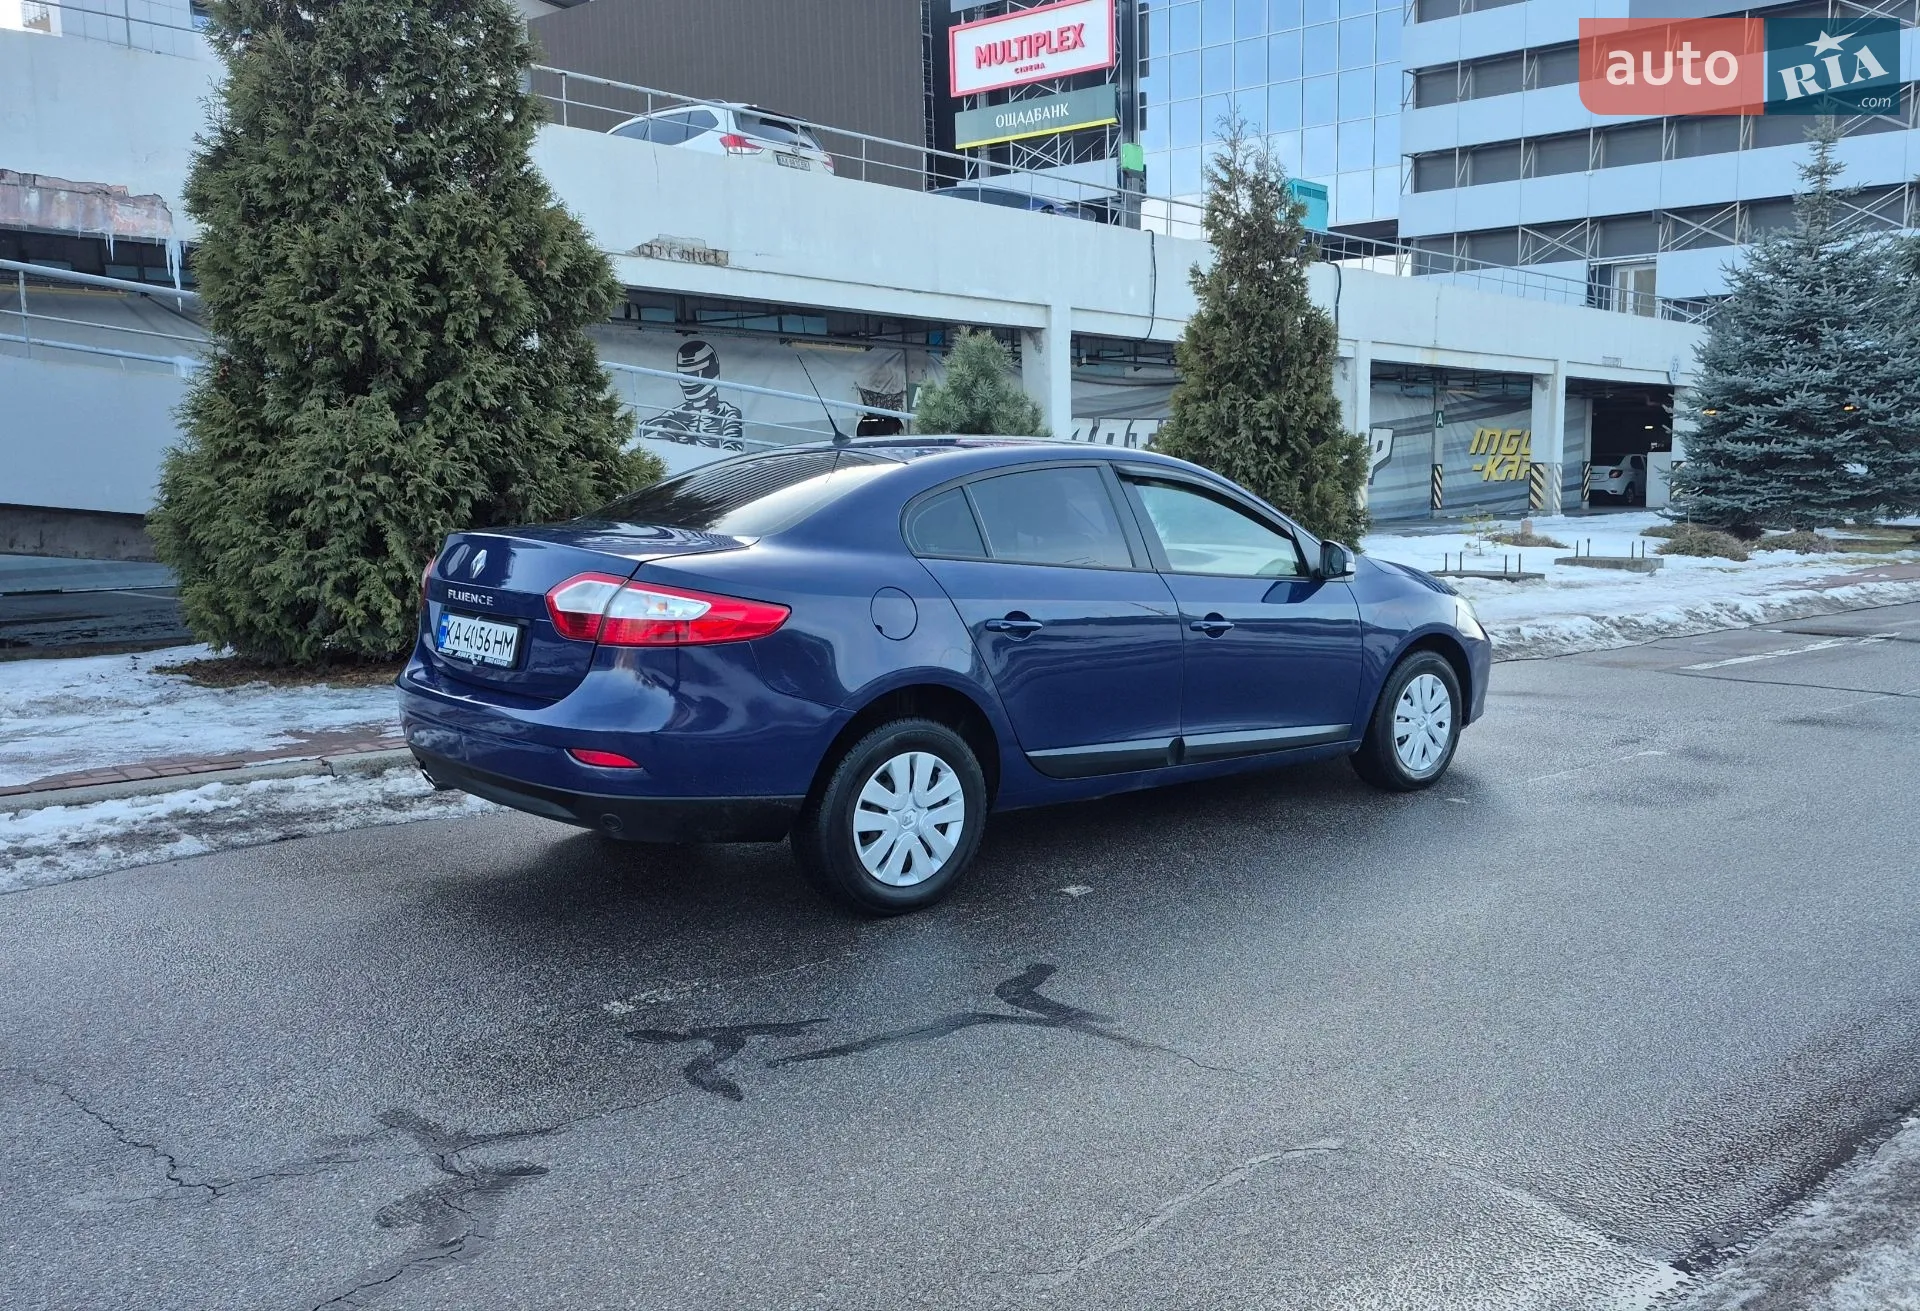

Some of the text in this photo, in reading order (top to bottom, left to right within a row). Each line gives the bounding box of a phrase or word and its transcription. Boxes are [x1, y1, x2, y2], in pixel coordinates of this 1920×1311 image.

[975, 23, 1085, 68] MULTIPLEX
[1014, 63, 1045, 74] CINEMA
[996, 102, 1069, 128] ОЩАДБАНК
[1436, 412, 1443, 426] A
[448, 589, 493, 606] FLUENCE
